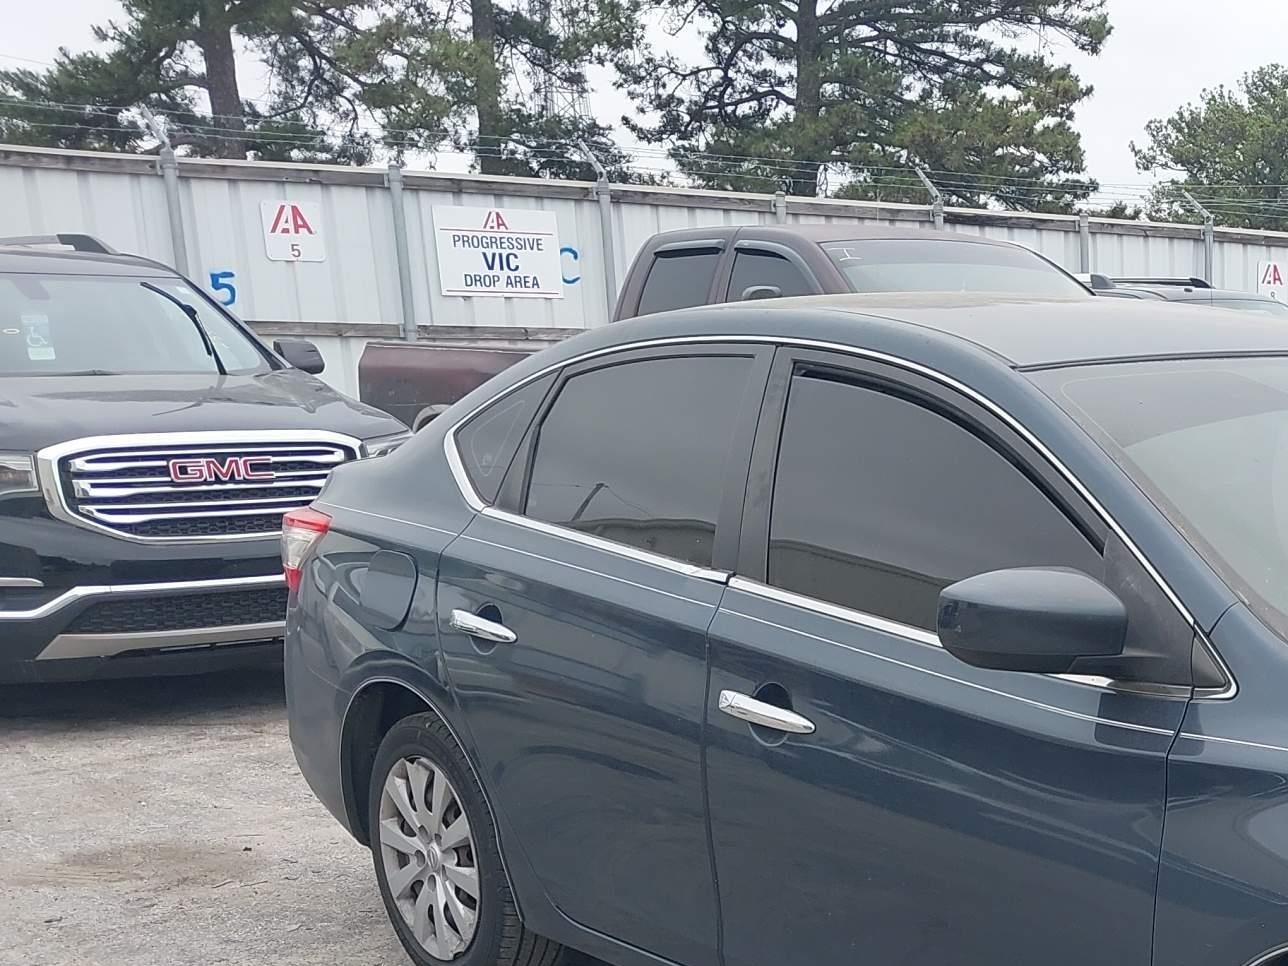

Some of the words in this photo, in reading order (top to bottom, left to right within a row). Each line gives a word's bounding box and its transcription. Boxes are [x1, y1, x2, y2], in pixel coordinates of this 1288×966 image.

[290, 243, 302, 258] 5
[453, 234, 545, 252] PROGRESSIVE
[482, 251, 520, 272] VIC
[209, 271, 237, 307] 5
[464, 273, 501, 289] DROP
[506, 276, 541, 290] AREA
[168, 456, 276, 482] GMC
